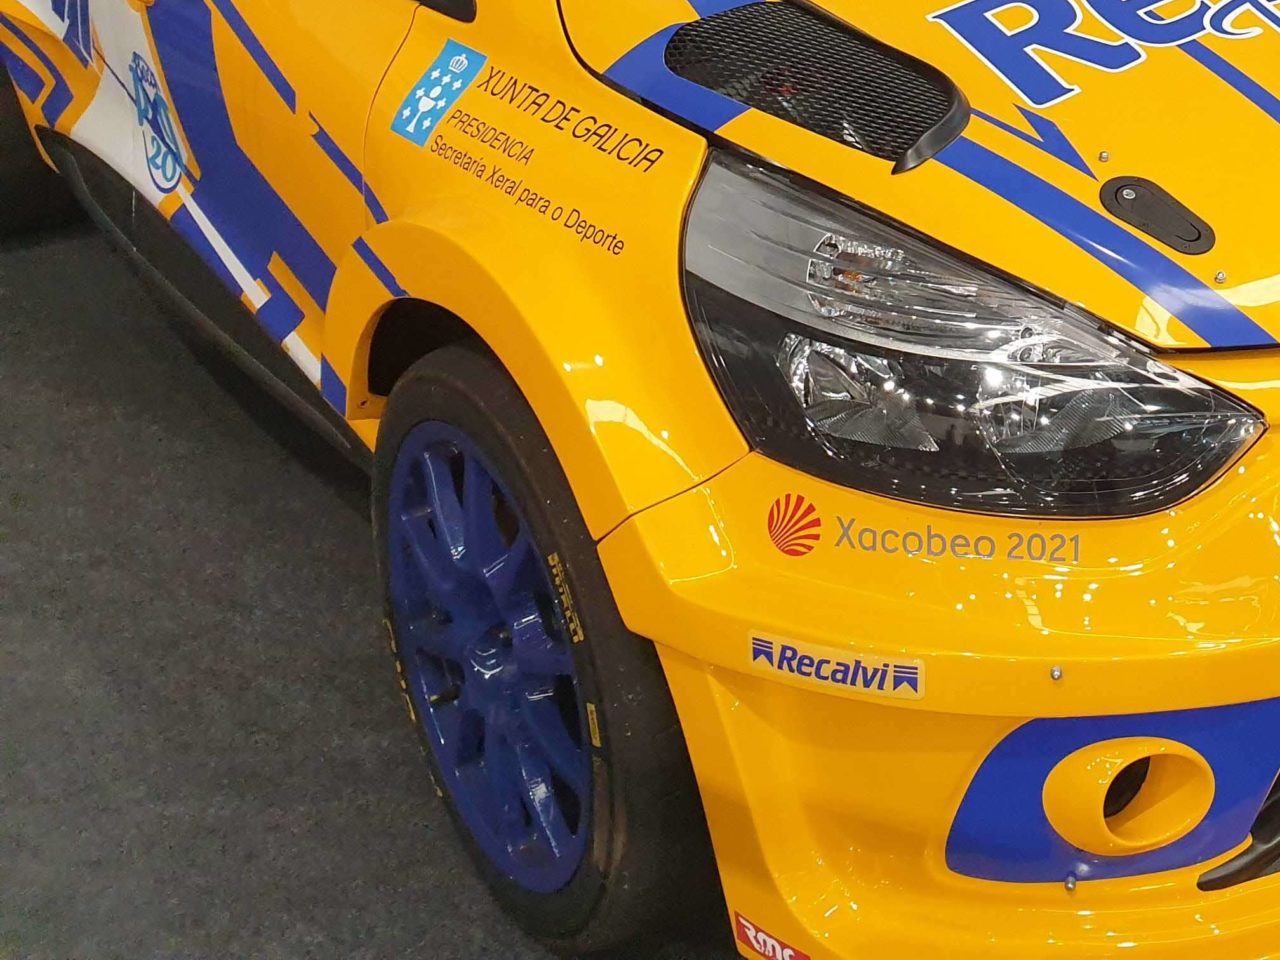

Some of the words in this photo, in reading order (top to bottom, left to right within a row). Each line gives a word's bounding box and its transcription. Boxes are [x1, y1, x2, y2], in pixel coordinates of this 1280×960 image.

[446, 108, 537, 167] PRESIDENCIA
[477, 65, 551, 116] XUNTA
[540, 99, 582, 131] DE
[571, 114, 665, 174] GALICIA
[430, 133, 488, 179] Secretaría
[484, 165, 526, 198] Xeral
[514, 187, 551, 216] para
[551, 204, 565, 222] o
[563, 207, 626, 257] Deporte
[834, 515, 997, 561] Xacobeo
[1005, 532, 1082, 563] 2021
[776, 643, 890, 692] Recalvi
